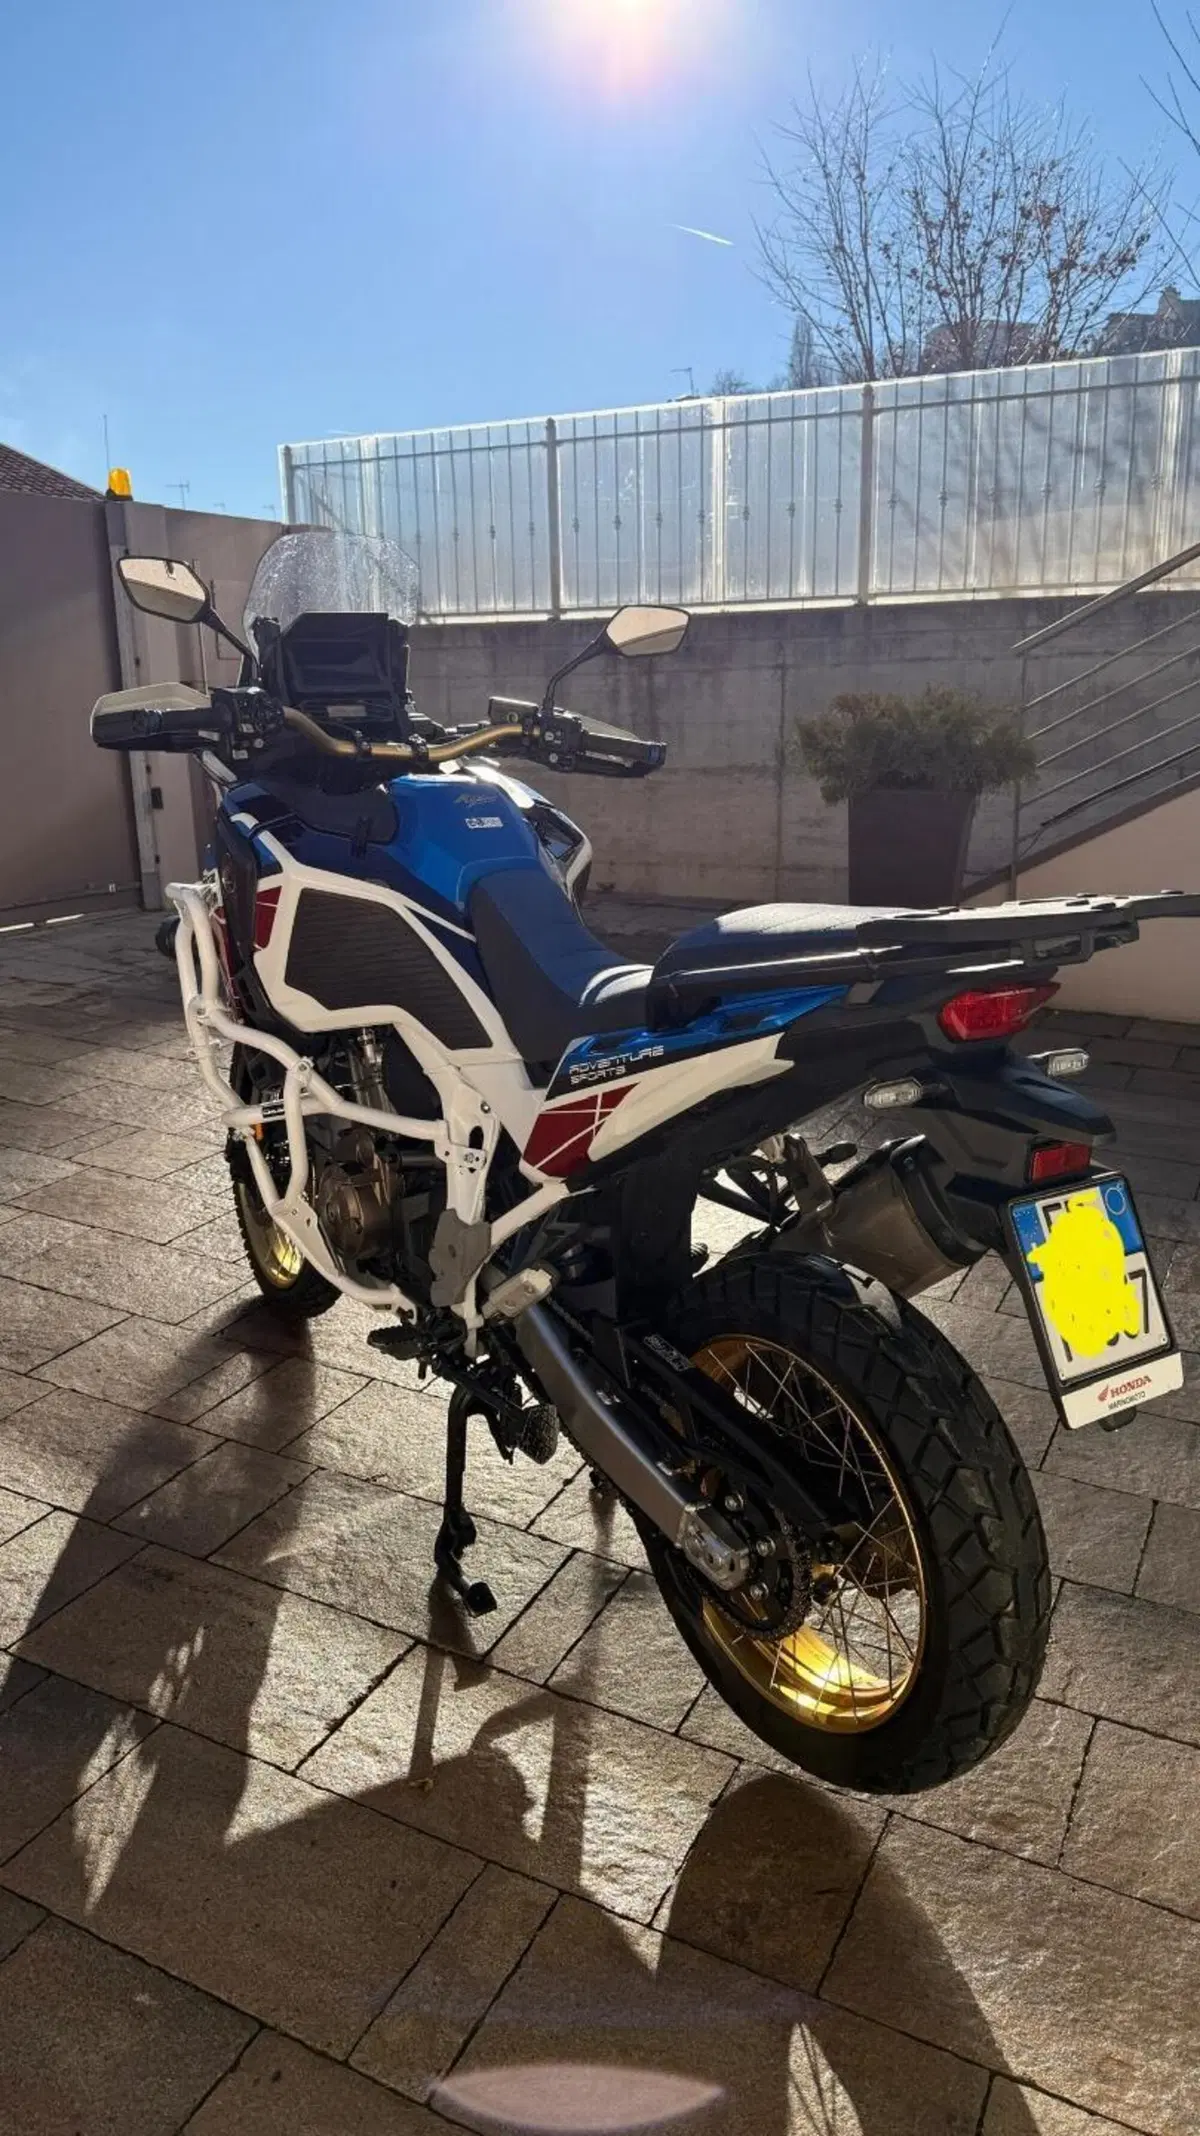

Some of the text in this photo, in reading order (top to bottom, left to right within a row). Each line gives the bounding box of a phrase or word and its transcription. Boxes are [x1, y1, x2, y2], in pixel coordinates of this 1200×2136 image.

[569, 1045, 664, 1074] ADVENTURE
[571, 1065, 625, 1084] SPORTS
[1110, 1375, 1152, 1398] HONDA
